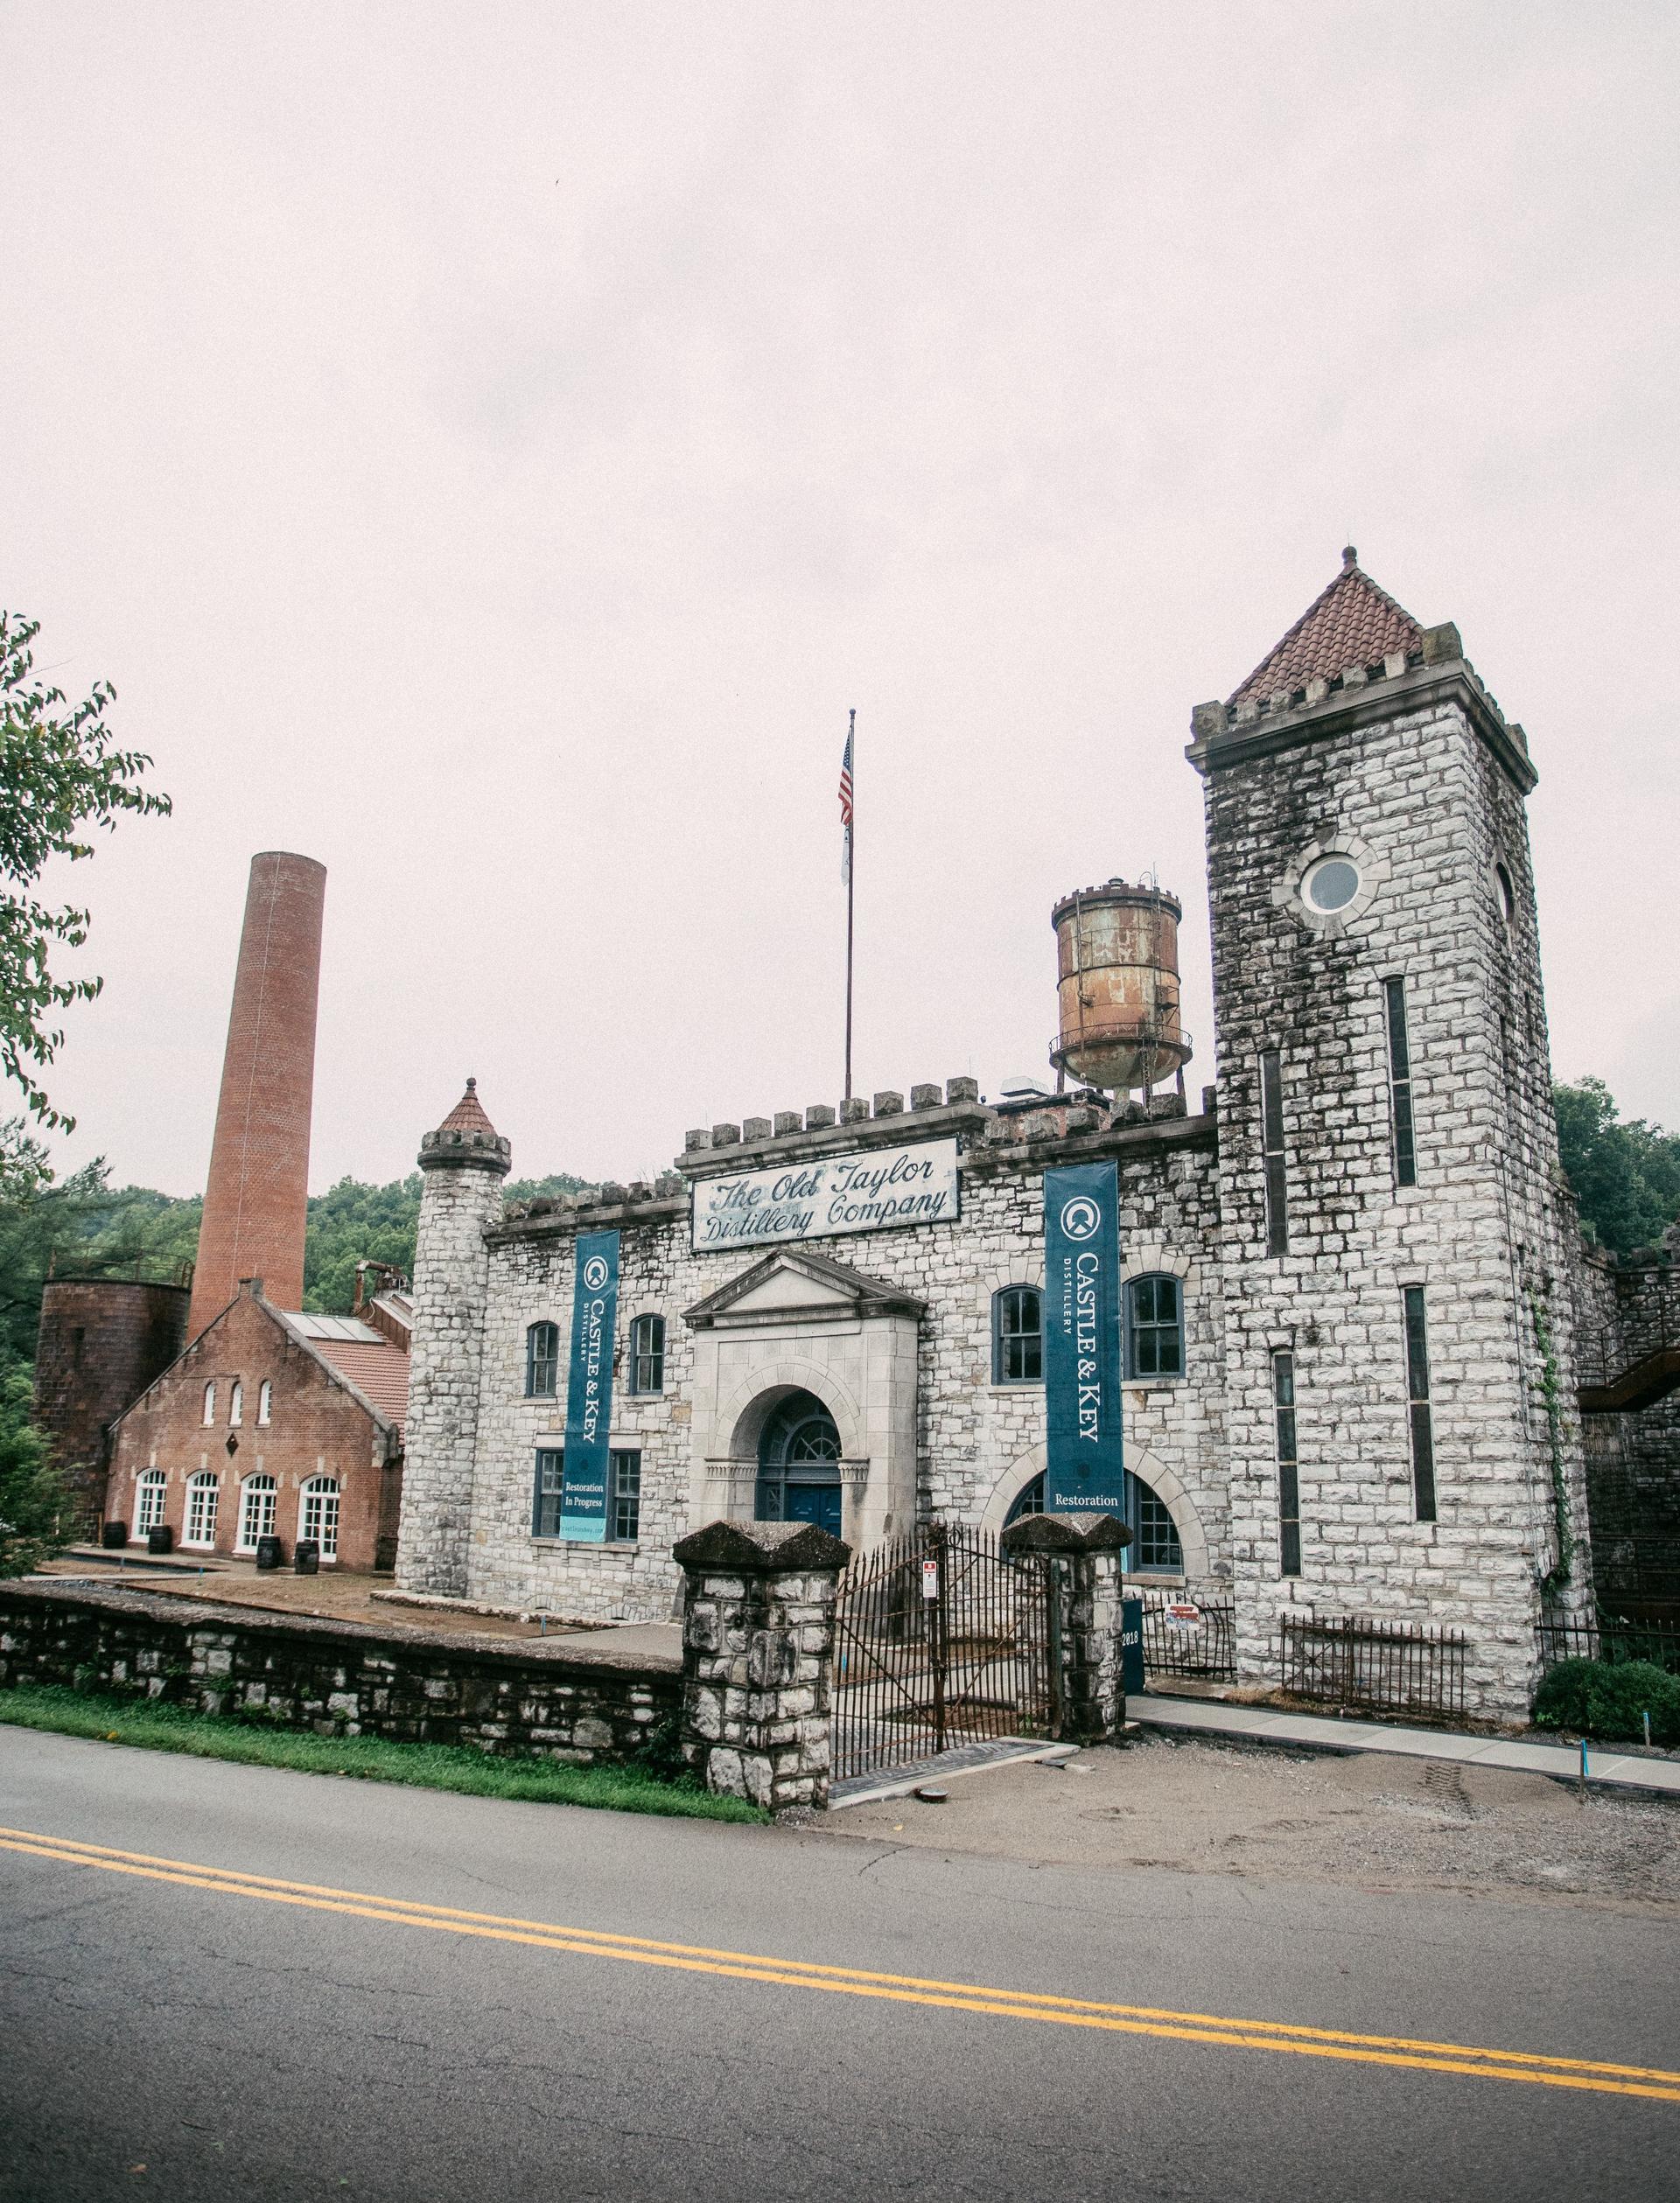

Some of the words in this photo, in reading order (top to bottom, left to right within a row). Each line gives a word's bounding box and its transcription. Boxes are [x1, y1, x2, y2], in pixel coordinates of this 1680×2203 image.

[710, 1180, 762, 1210] The
[772, 1170, 825, 1201] Old
[831, 1154, 934, 1199] Taylor
[700, 1208, 815, 1242] Distillery
[828, 1191, 948, 1226] Company
[1063, 1257, 1072, 1334] DISTILLERY
[1076, 1252, 1099, 1354] CASTLE
[580, 1303, 590, 1361] DISTILLERY
[587, 1298, 605, 1376] CASTLE
[586, 1380, 598, 1396] &
[1077, 1358, 1097, 1381] &
[583, 1398, 599, 1444] KEY
[1078, 1381, 1101, 1443] KEY
[565, 1481, 604, 1493] Restoration
[565, 1496, 573, 1506] In
[574, 1496, 603, 1509] Progress
[1055, 1493, 1118, 1507] Restoration
